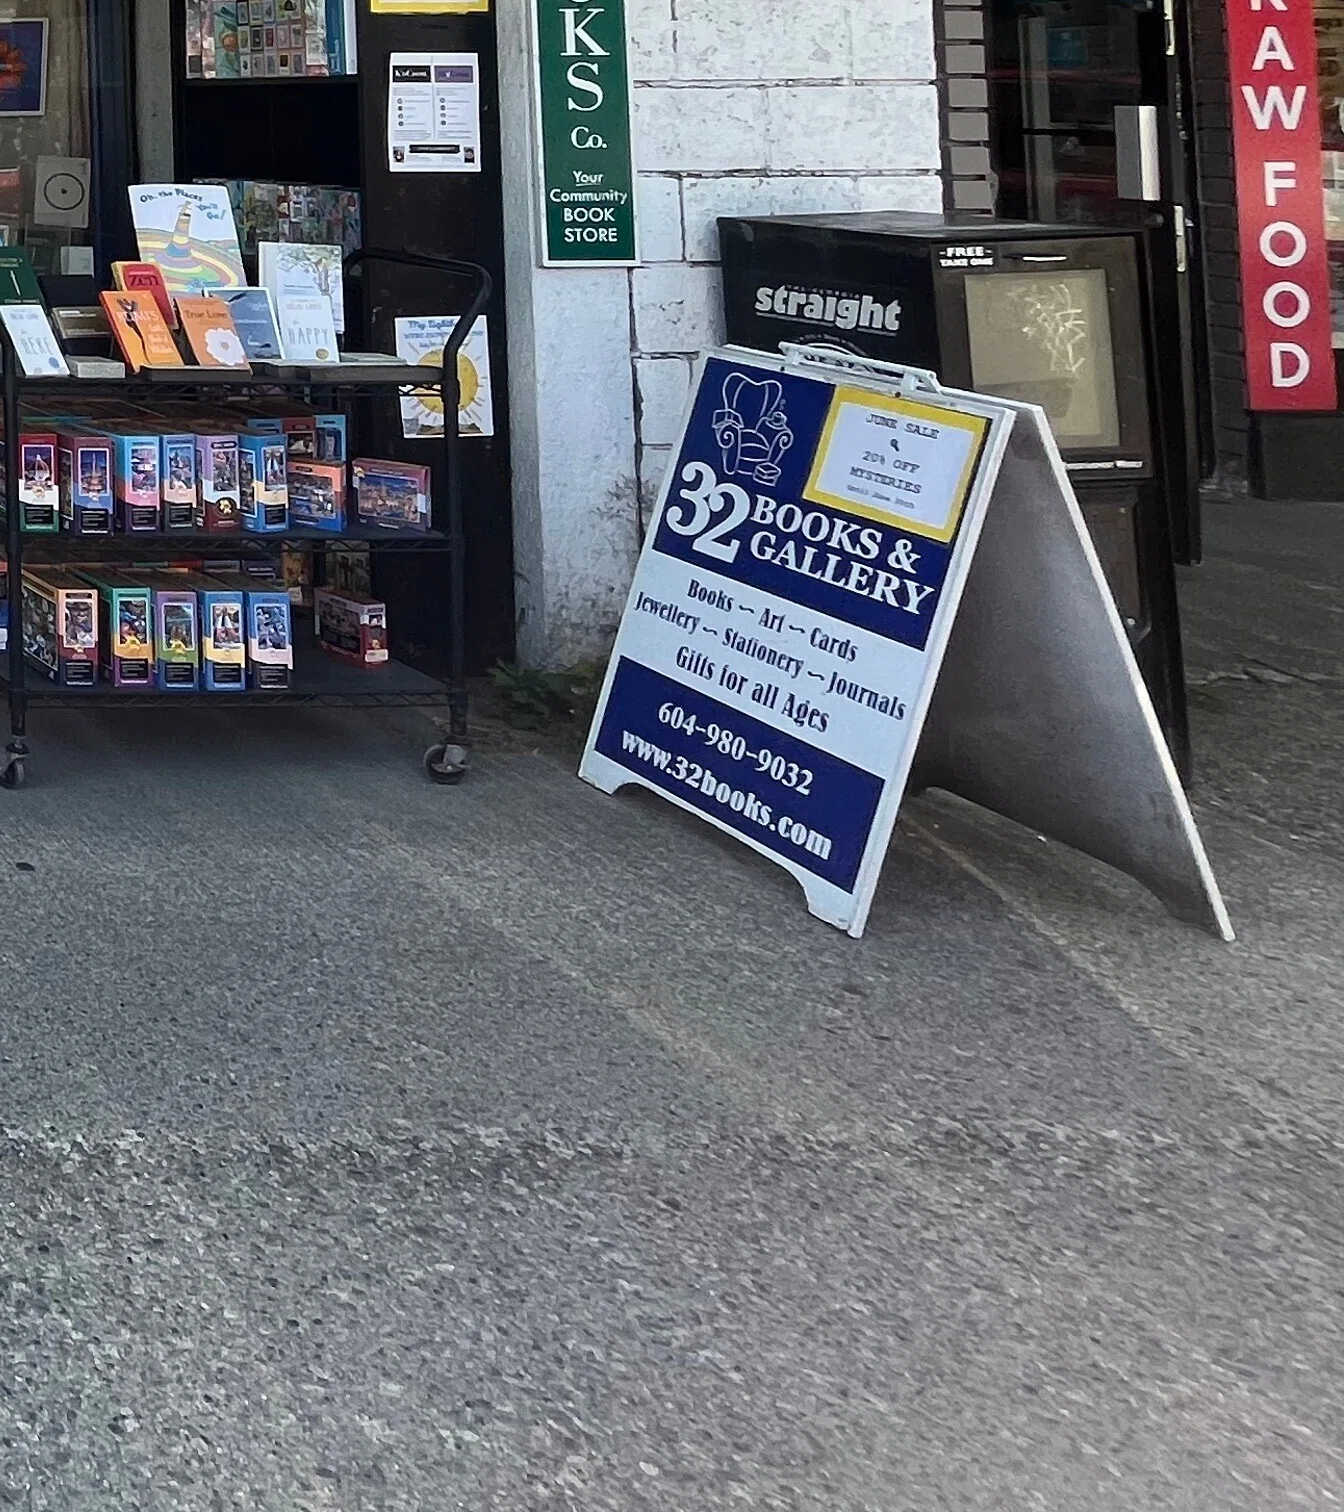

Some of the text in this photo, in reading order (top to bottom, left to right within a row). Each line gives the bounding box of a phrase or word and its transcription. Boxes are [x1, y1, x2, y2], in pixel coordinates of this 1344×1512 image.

[570, 124, 608, 150] Co.
[549, 188, 628, 206] Community
[572, 170, 604, 185] Your
[563, 207, 615, 224] BOOK
[564, 227, 618, 244] STORE
[1258, 160, 1311, 389] FOOD
[754, 284, 903, 330] straight
[866, 413, 939, 439] JUNE SALE
[849, 466, 922, 494] MYSTERIES
[893, 459, 920, 474] OFF
[666, 461, 922, 574] 32 BOOKS &
[750, 532, 935, 615] GALLERY
[687, 579, 859, 663] Books Art Cards
[634, 591, 907, 721] Jewellery Stationery Journals
[676, 645, 831, 734] Gifts for all Ages
[657, 701, 814, 797] 604-980-9032
[621, 729, 832, 861] www.32books.com
